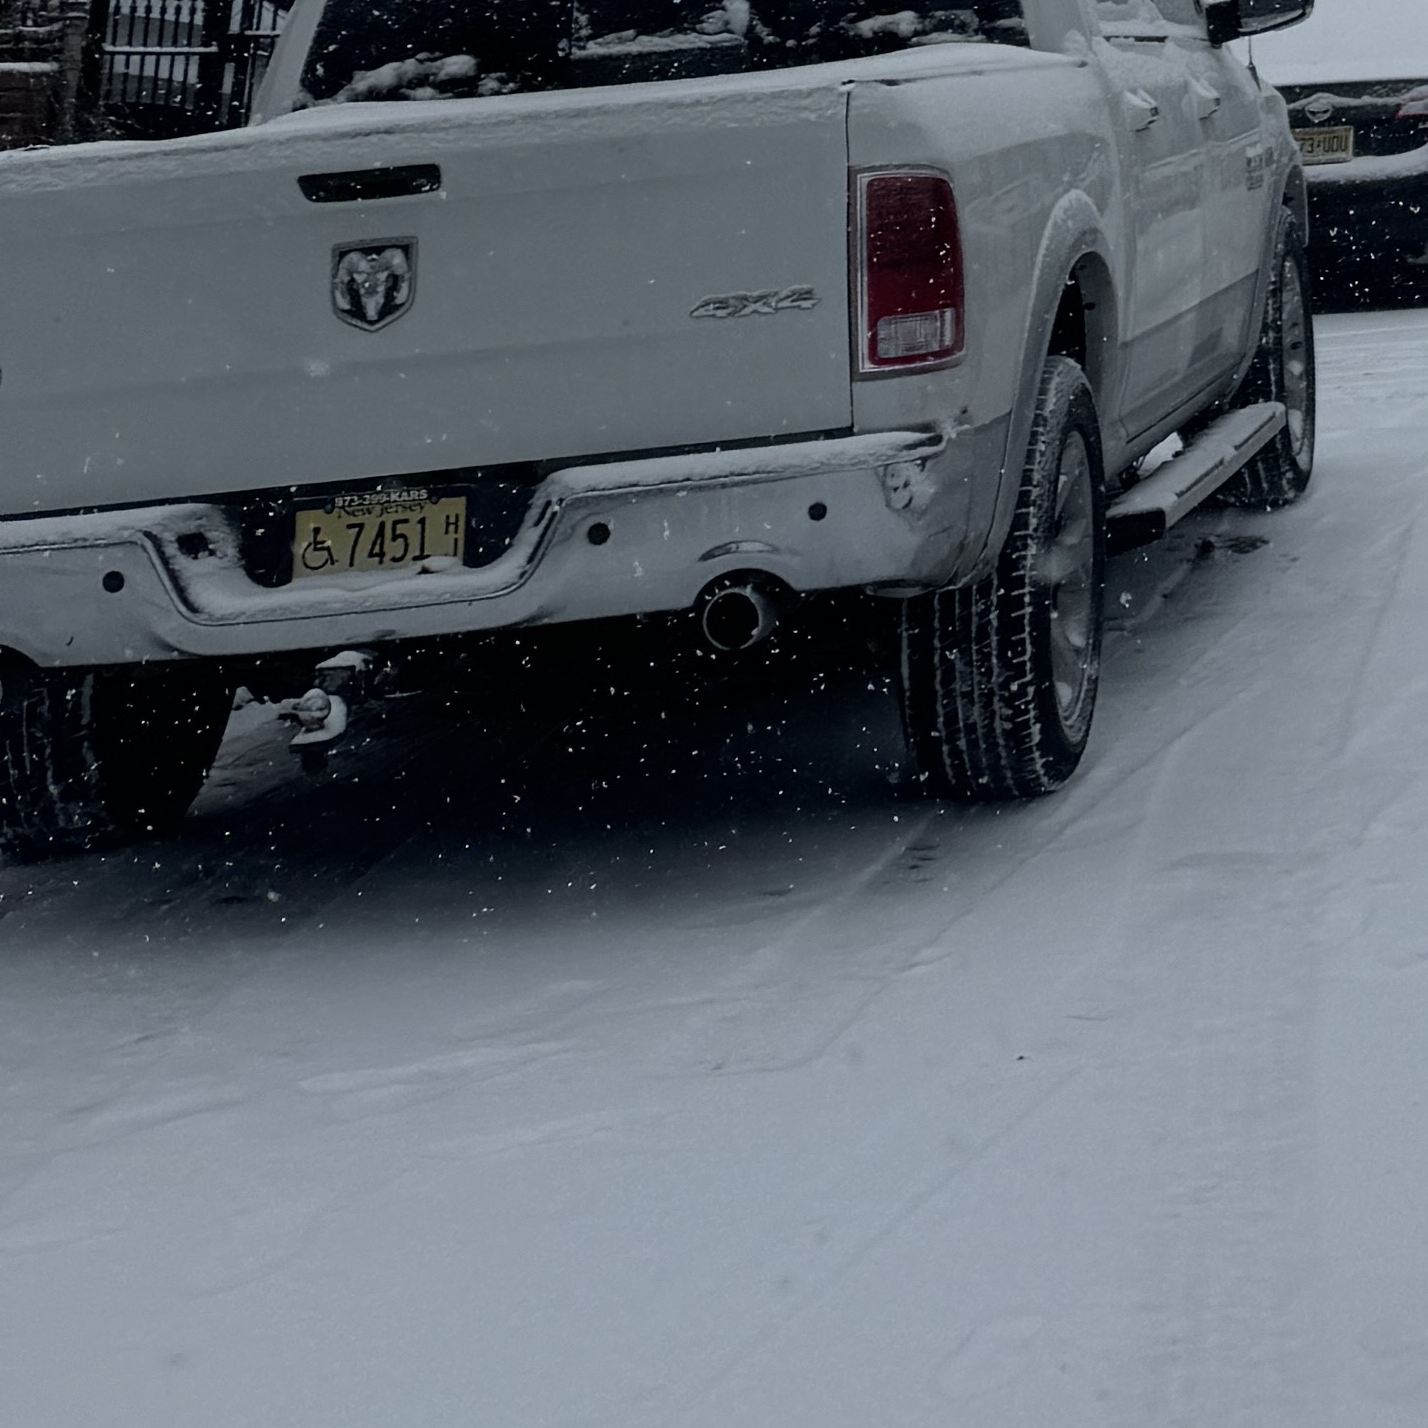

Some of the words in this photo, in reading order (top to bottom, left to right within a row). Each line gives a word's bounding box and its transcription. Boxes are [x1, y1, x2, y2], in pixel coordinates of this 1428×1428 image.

[334, 489, 428, 507] 973-399-KARS
[337, 504, 373, 520] New
[376, 501, 427, 518] Jersey
[346, 516, 431, 568] 7451
